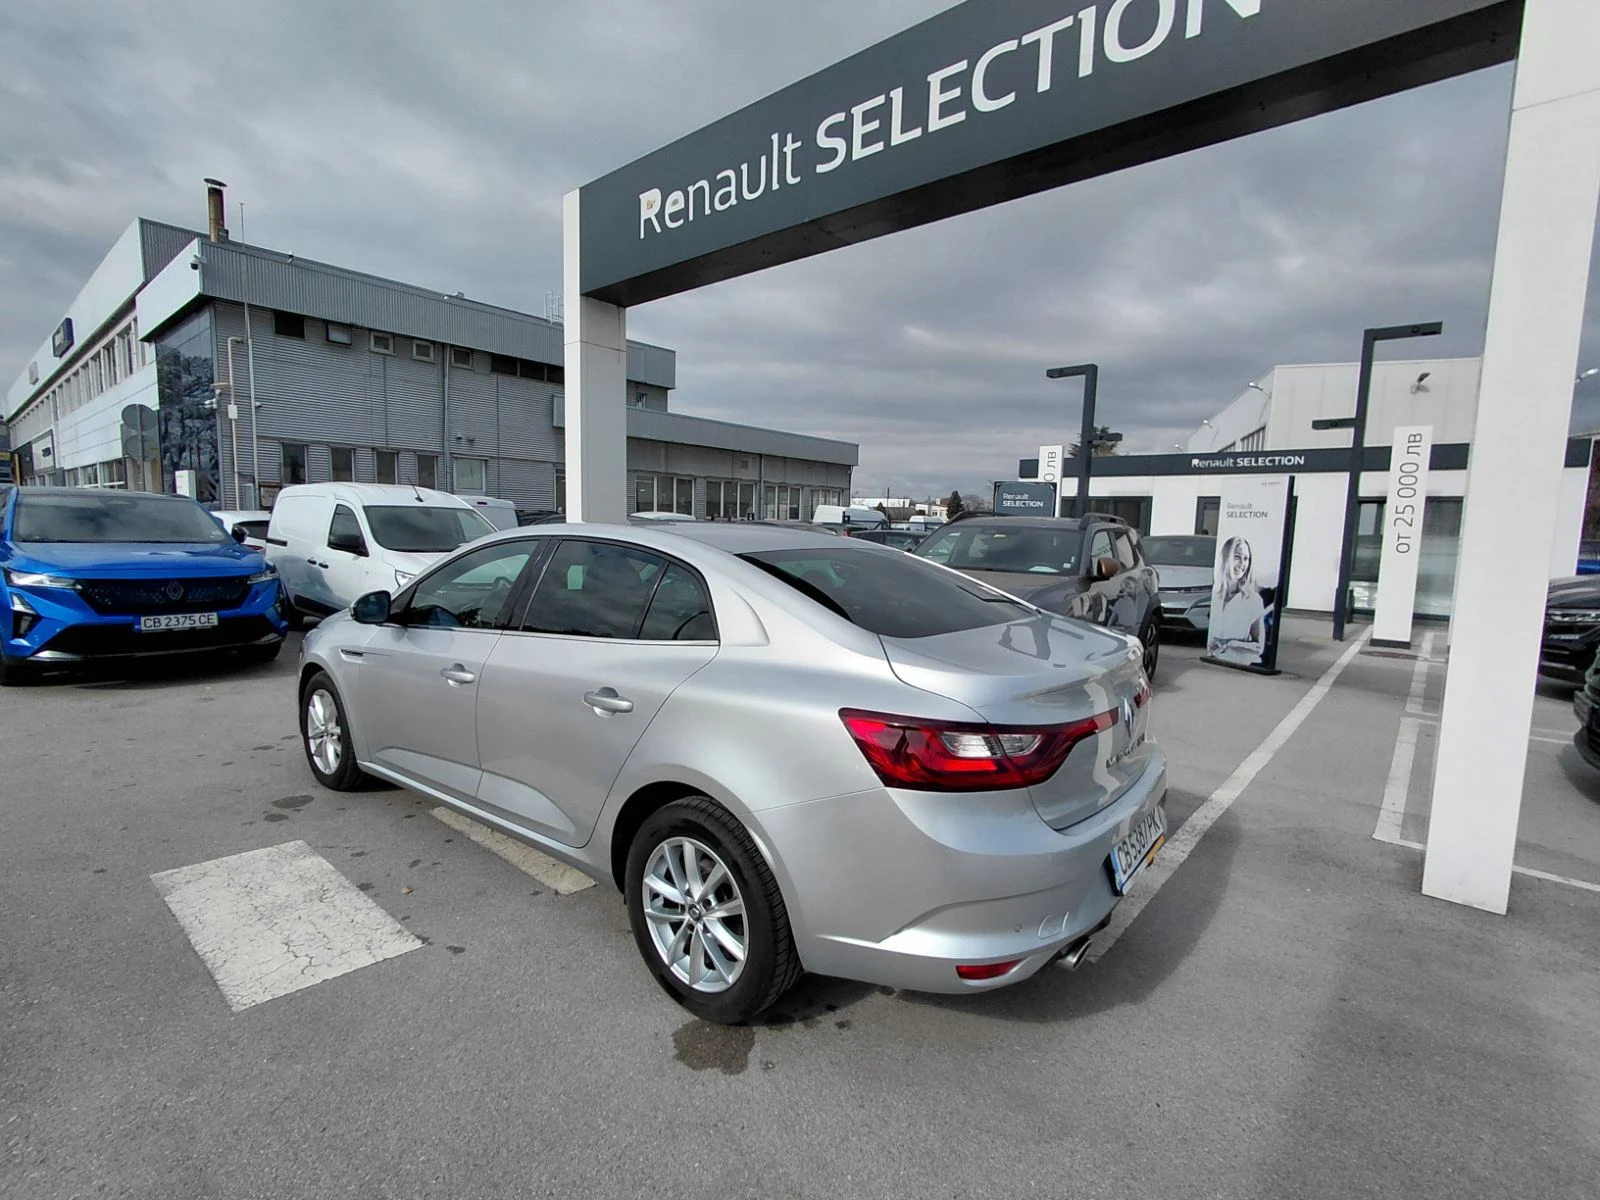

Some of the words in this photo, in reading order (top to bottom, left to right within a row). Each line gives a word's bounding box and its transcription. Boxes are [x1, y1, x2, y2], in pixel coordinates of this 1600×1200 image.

[639, 132, 801, 240] Renault
[1406, 433, 1423, 456] лв
[1191, 457, 1235, 468] Renault
[1236, 455, 1305, 467] SELECTION
[1397, 462, 1420, 498] 000
[1002, 492, 1030, 500] Renault
[1002, 500, 1044, 508] SELECTION
[1226, 502, 1253, 510] Renault
[1226, 511, 1268, 519] SELECTION
[1394, 504, 1415, 527] 25
[1396, 532, 1412, 554] от
[164, 615, 197, 627] 2375
